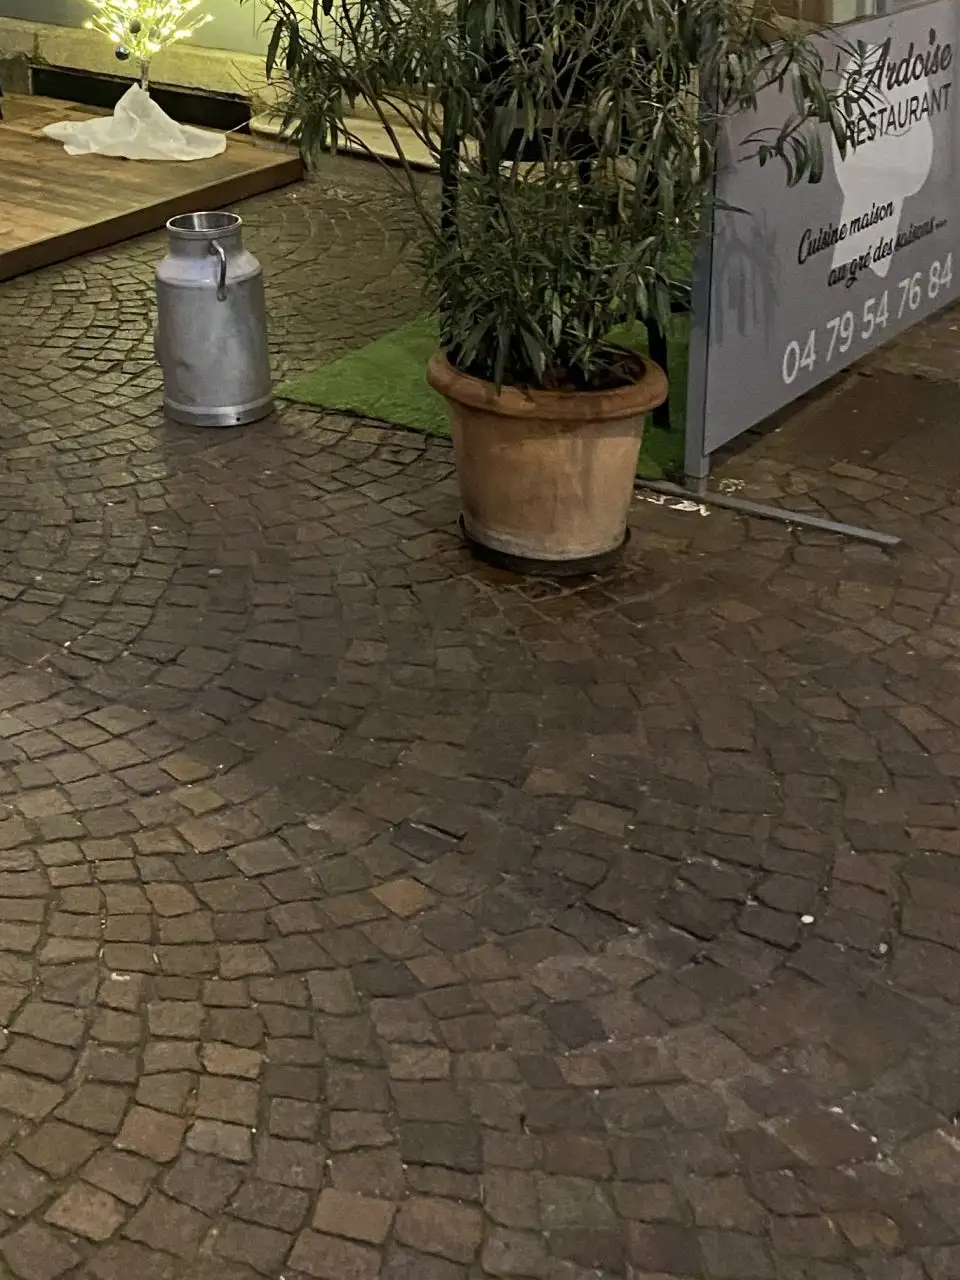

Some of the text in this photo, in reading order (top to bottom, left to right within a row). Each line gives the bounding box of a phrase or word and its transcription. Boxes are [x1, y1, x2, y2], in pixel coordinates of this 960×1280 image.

[798, 201, 894, 265] Cuisine maison
[828, 262, 848, 287] au
[845, 246, 871, 288] gré
[873, 237, 893, 262] des
[782, 252, 952, 384] 04 79 54 76 84
